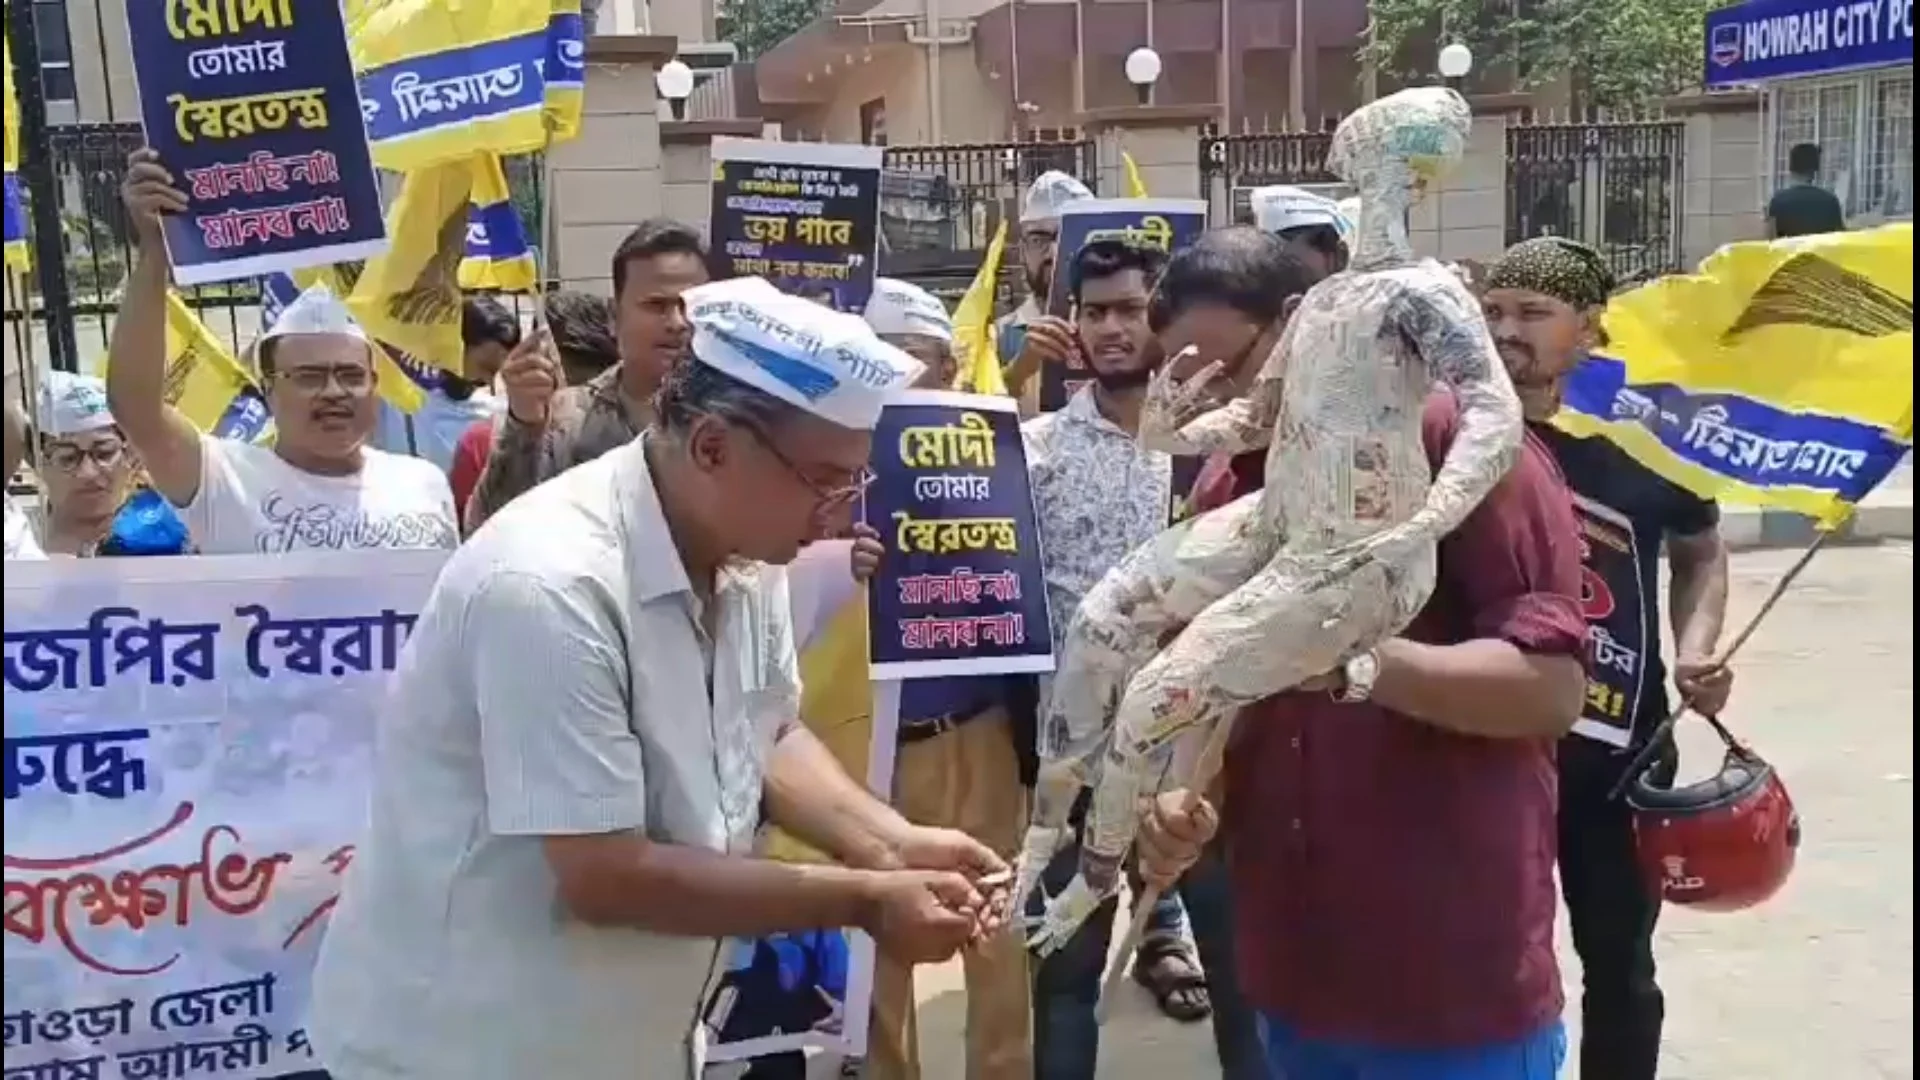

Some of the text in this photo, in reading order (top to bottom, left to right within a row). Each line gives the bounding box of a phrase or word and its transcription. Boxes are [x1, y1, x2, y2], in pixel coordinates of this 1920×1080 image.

[1744, 8, 1828, 62] HOWRAH
[1834, 0, 1883, 48] CITY
[188, 40, 287, 78] তোমার
[166, 87, 329, 142] স্বৈরতন্ত্র
[184, 150, 289, 199] মানছি
[196, 204, 296, 249] মানব
[743, 214, 853, 246] ভয় পাবে
[899, 412, 995, 467] মোদী
[915, 472, 990, 502] তোমার
[890, 510, 1017, 554] স্বৈরতন্ত্র
[898, 566, 982, 604] মানছি
[234, 604, 420, 679] স্বৈরা
[898, 615, 980, 649] মানব
[150, 971, 277, 1031] জেলা
[116, 1023, 273, 1080] আদমী
